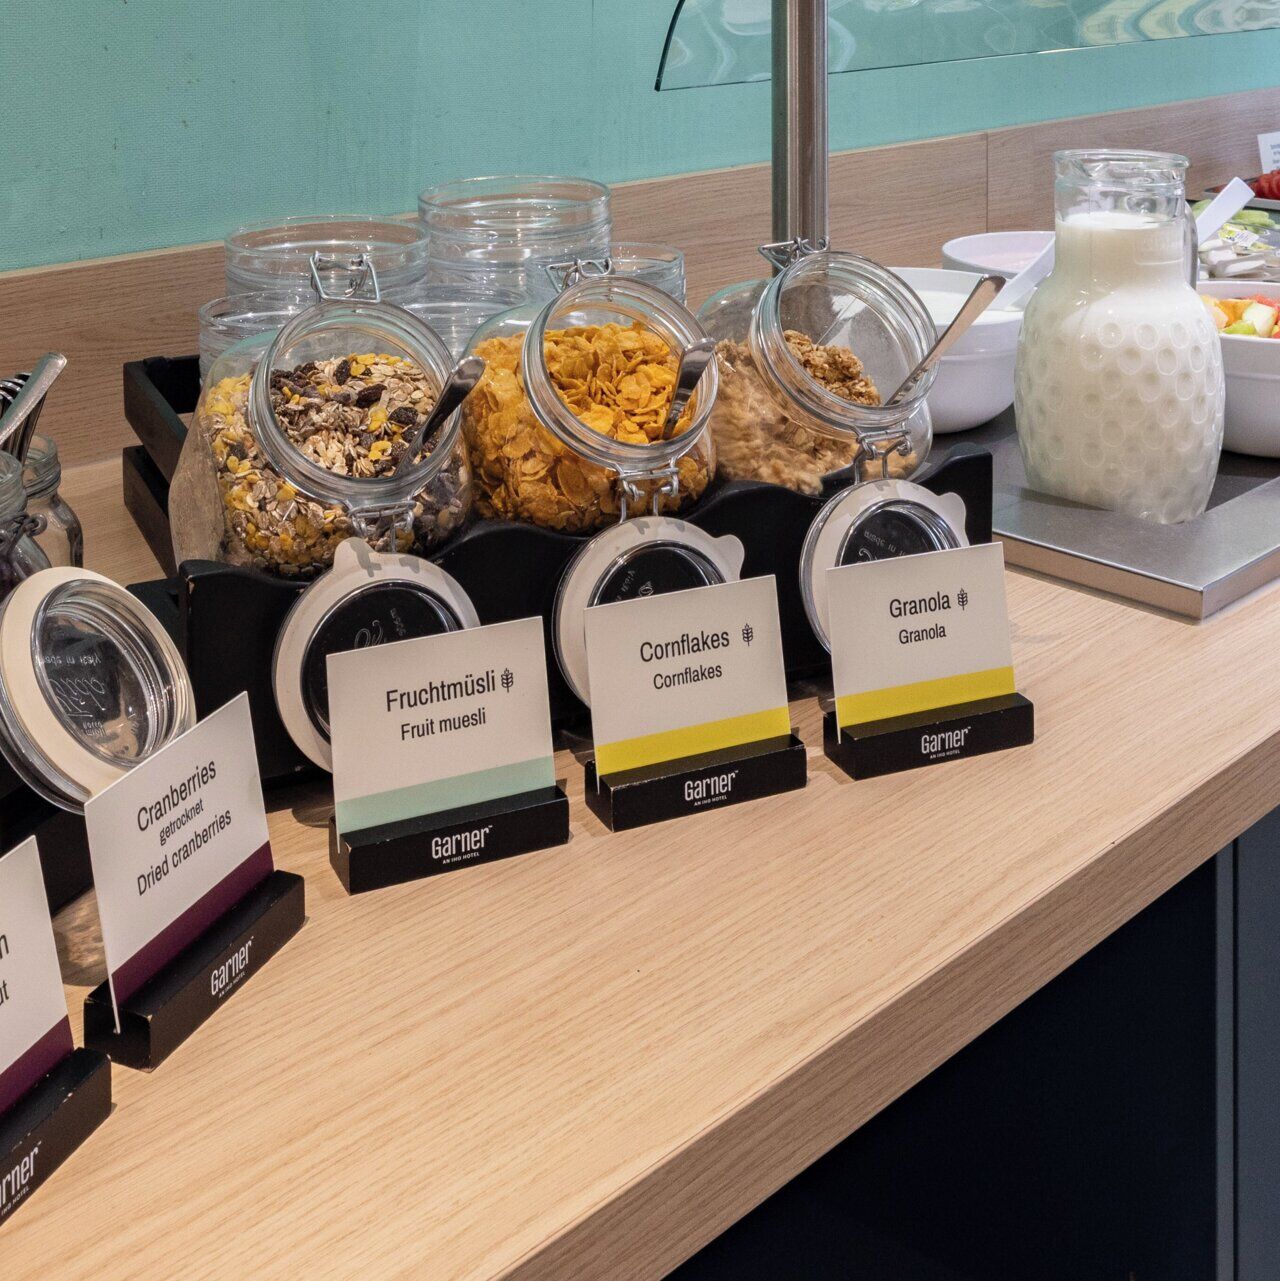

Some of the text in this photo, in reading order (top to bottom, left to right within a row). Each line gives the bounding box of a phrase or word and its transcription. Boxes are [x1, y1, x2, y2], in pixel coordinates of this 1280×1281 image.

[889, 591, 952, 618] Granola
[639, 630, 730, 663] Cornflakes
[898, 623, 947, 645] Granola
[386, 669, 496, 712] Fruchtmüsli
[653, 664, 723, 690] Cornflakes
[400, 707, 487, 741] Fruit muesli
[136, 760, 218, 833] Cranberries
[159, 798, 205, 846] getrocknet
[136, 808, 233, 897] Dried cranberries
